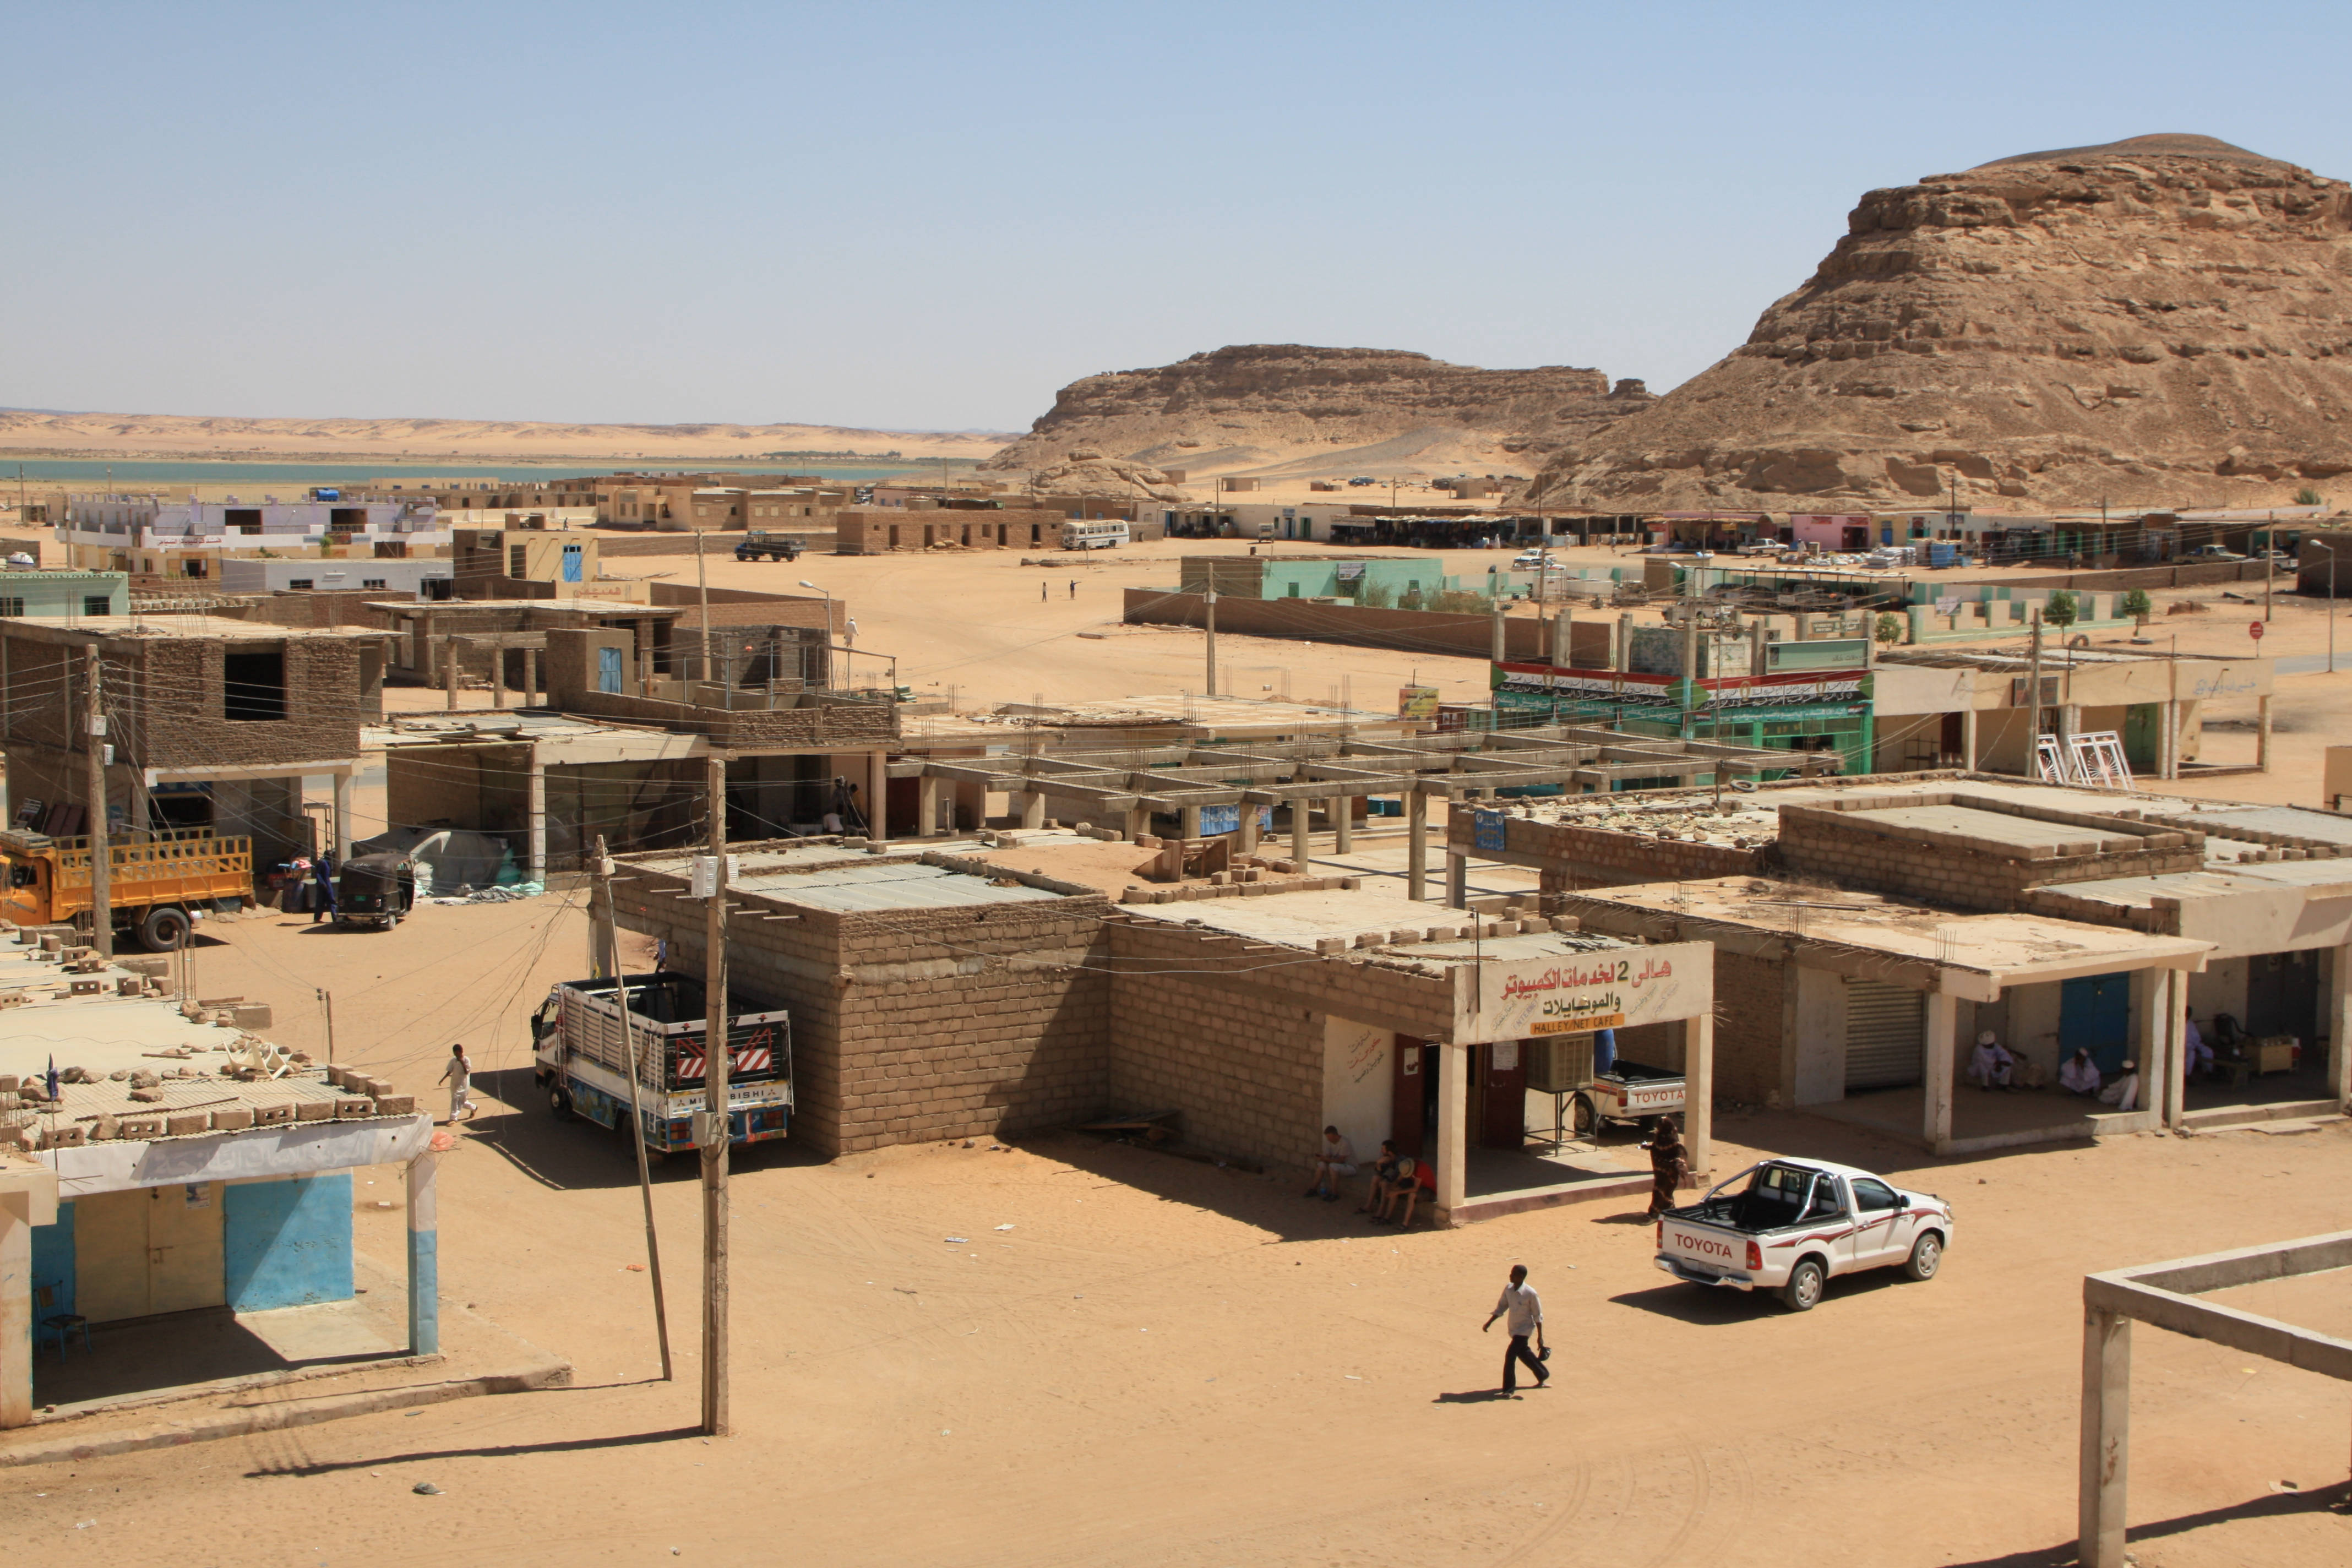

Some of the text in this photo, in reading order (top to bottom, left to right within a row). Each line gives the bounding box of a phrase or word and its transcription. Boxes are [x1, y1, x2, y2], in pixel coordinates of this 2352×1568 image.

[1500, 967, 1560, 1000] الكمبيوتر
[1561, 962, 1615, 988] لخدمات
[1617, 960, 1629, 982] 2
[1543, 990, 1621, 1018] والموبايلات
[1534, 1015, 1615, 1034] HALLEY NET CAFE
[1635, 1090, 1684, 1103] TOYOTA
[1675, 1233, 1733, 1259] TOYOTA
